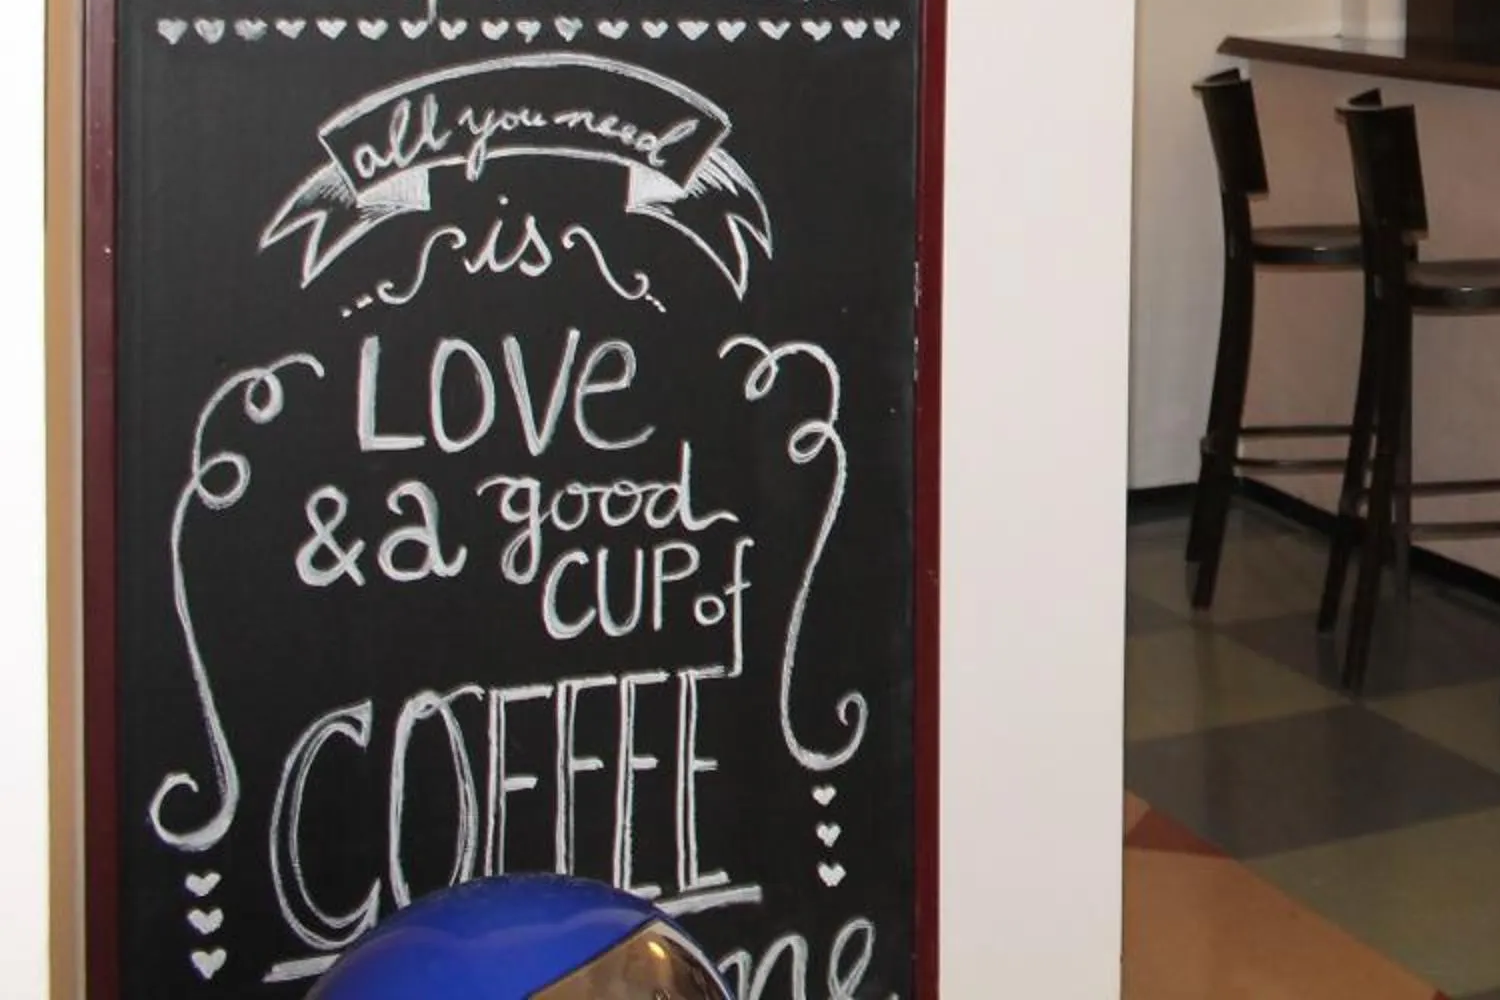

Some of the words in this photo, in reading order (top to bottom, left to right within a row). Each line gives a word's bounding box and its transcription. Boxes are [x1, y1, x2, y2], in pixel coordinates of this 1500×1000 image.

[353, 93, 453, 179] all
[458, 107, 547, 182] you
[554, 111, 700, 167] need
[463, 195, 553, 277] is
[377, 480, 468, 582] a
[476, 440, 740, 586] good
[541, 541, 700, 640] CUP
[693, 536, 755, 678] of
[270, 664, 730, 948] COFFEE
